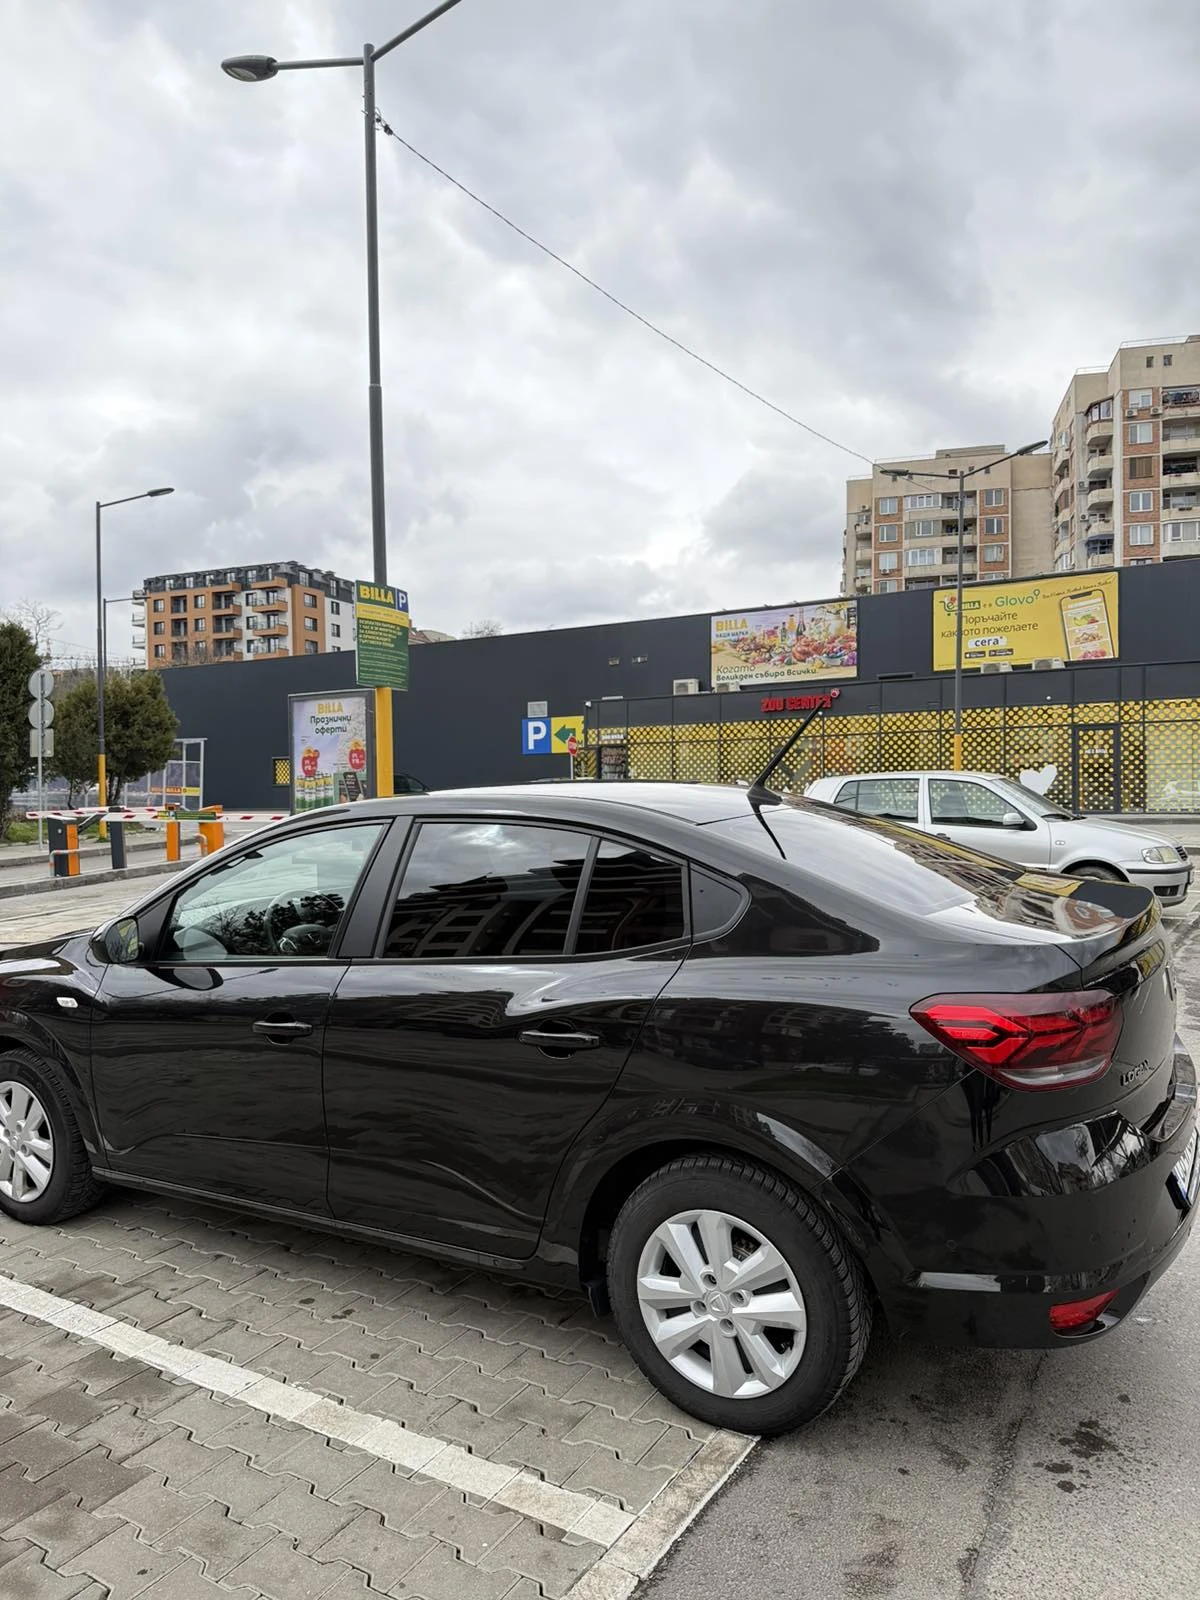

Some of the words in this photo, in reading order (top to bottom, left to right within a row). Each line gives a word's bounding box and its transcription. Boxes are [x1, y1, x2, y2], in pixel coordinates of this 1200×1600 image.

[360, 584, 394, 605] BILLA
[398, 592, 407, 608] P
[995, 595, 1034, 607] Glovo
[962, 611, 1018, 625] Поръчайте
[716, 618, 748, 631] BILLA
[983, 622, 1039, 634] пожелаете
[717, 664, 756, 674] Когато
[754, 670, 785, 679] събира
[317, 703, 344, 714] BILLA
[310, 715, 352, 726] Празнични
[314, 725, 347, 736] оферти
[527, 720, 547, 750] P
